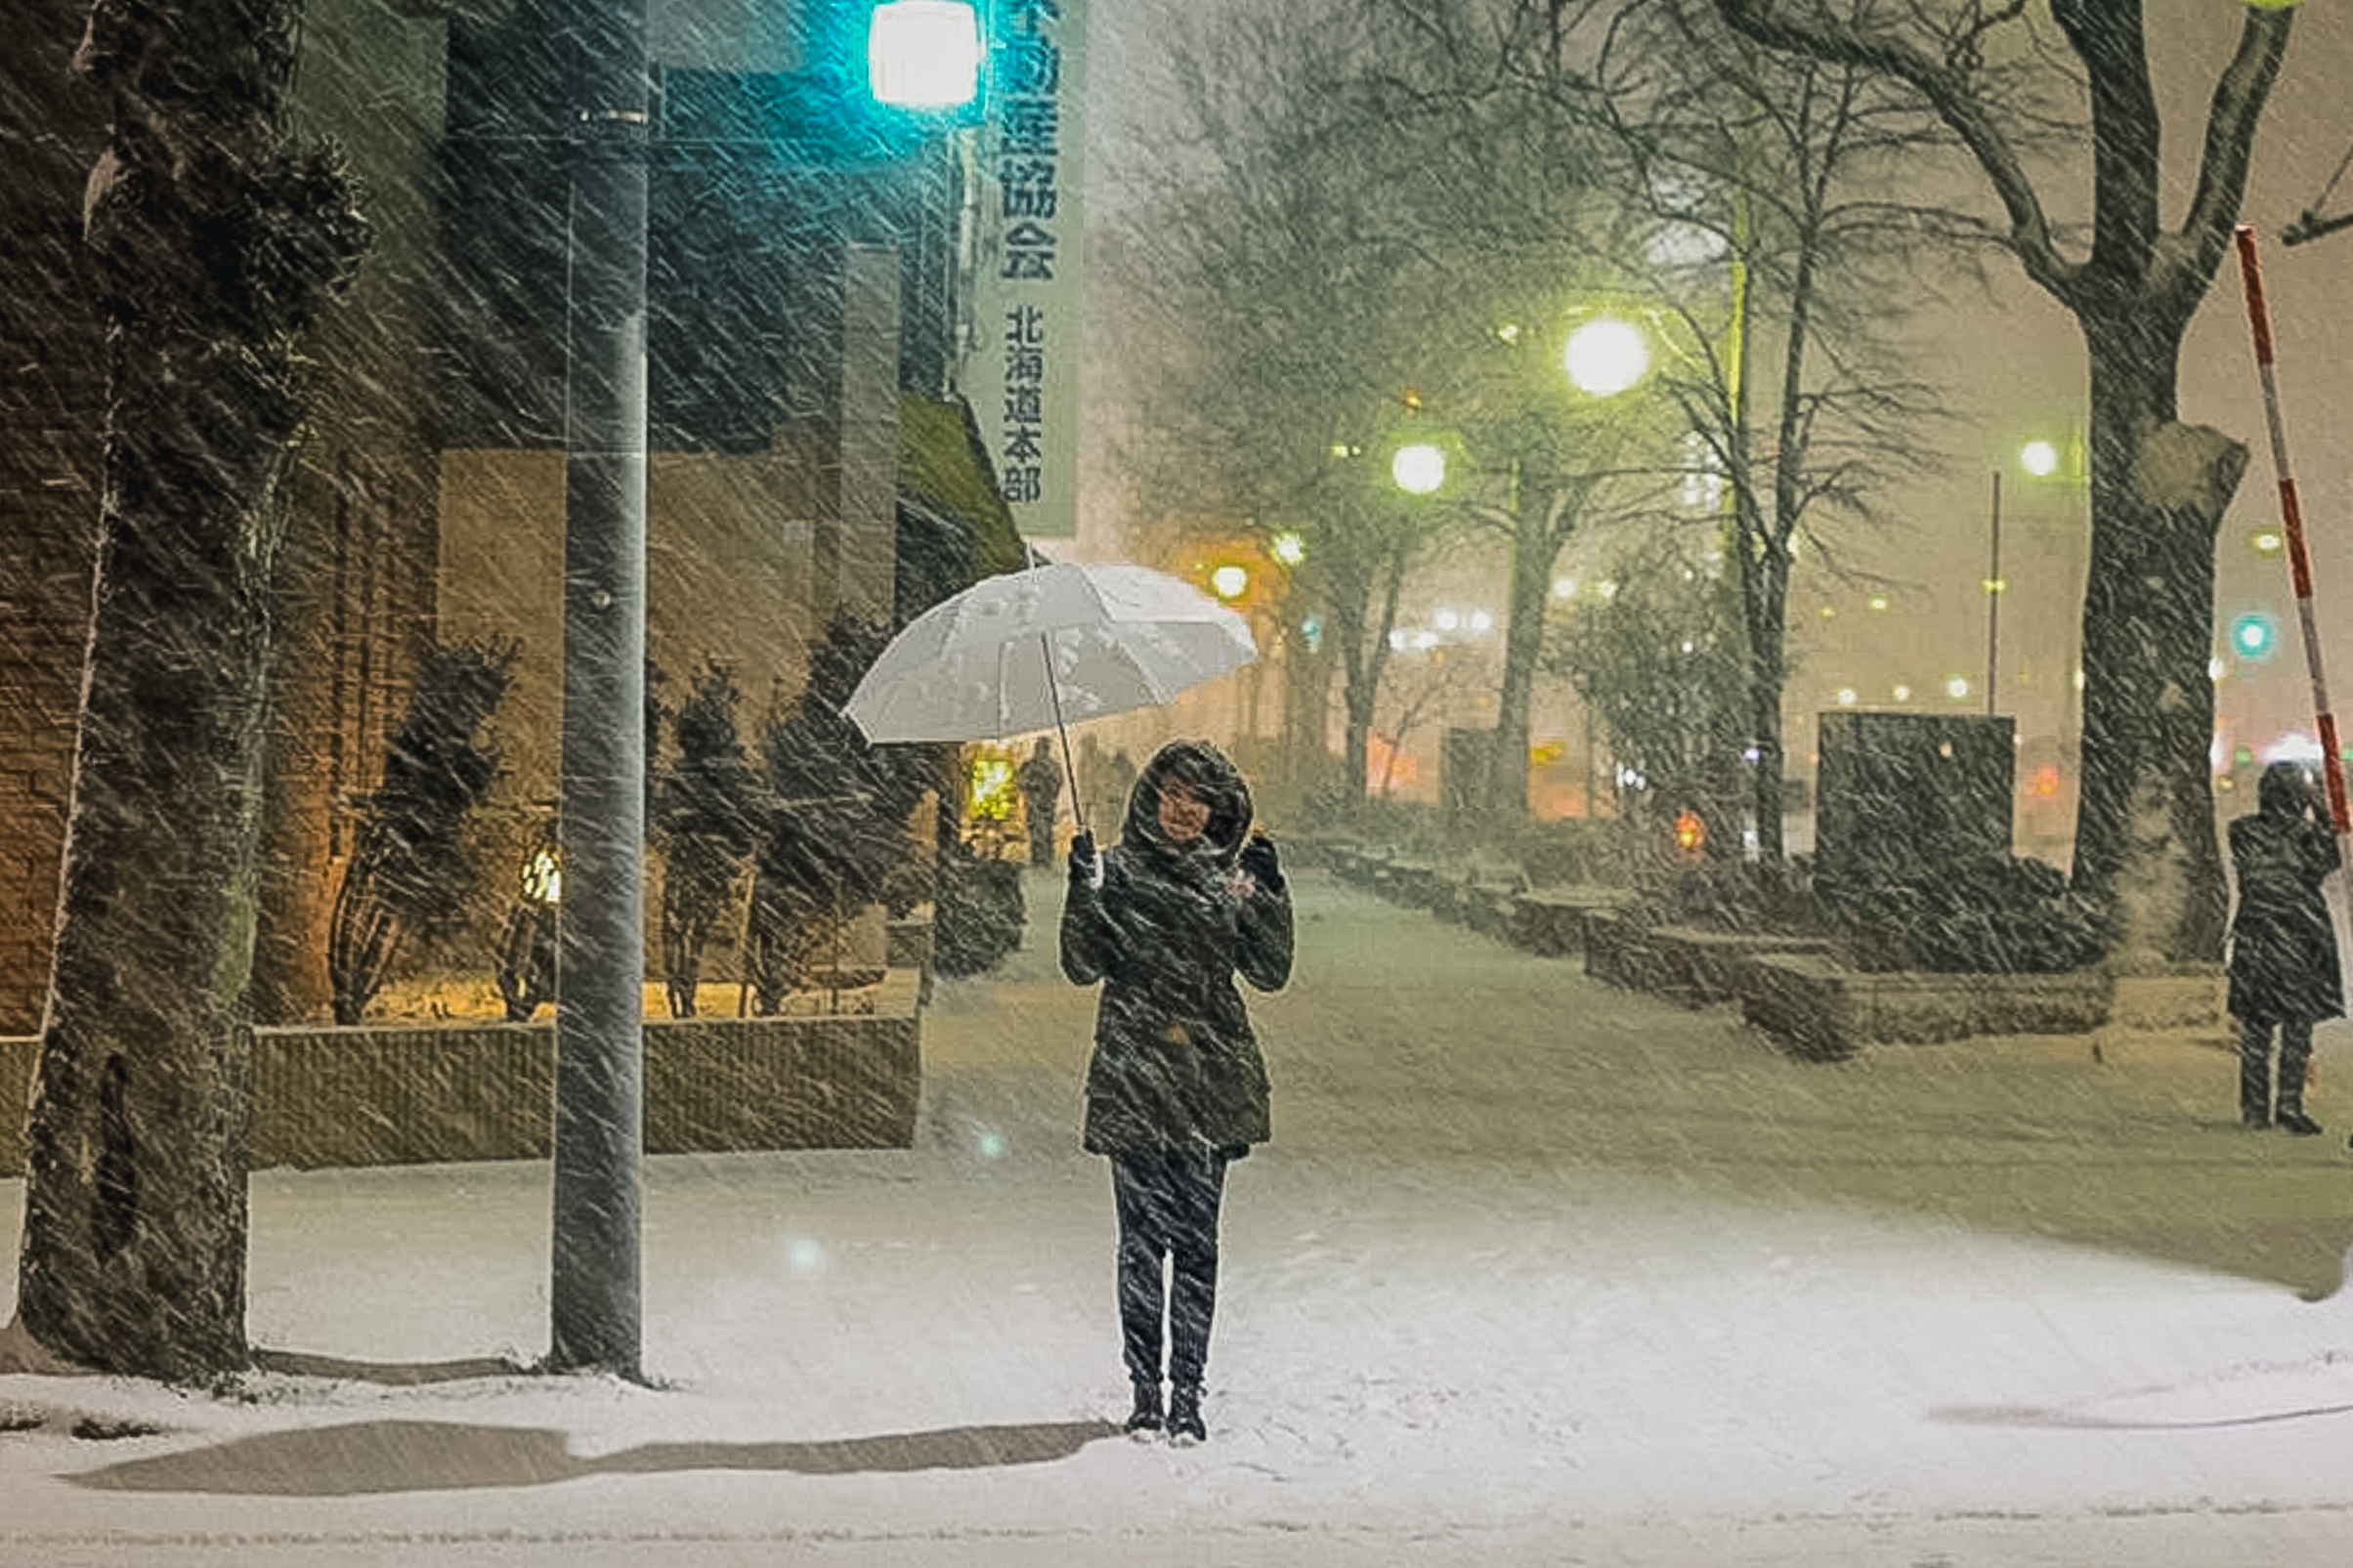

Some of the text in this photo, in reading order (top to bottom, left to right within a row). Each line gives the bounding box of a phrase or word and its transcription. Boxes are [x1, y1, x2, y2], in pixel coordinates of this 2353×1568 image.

[1004, 305, 1043, 502] 北海道本部
